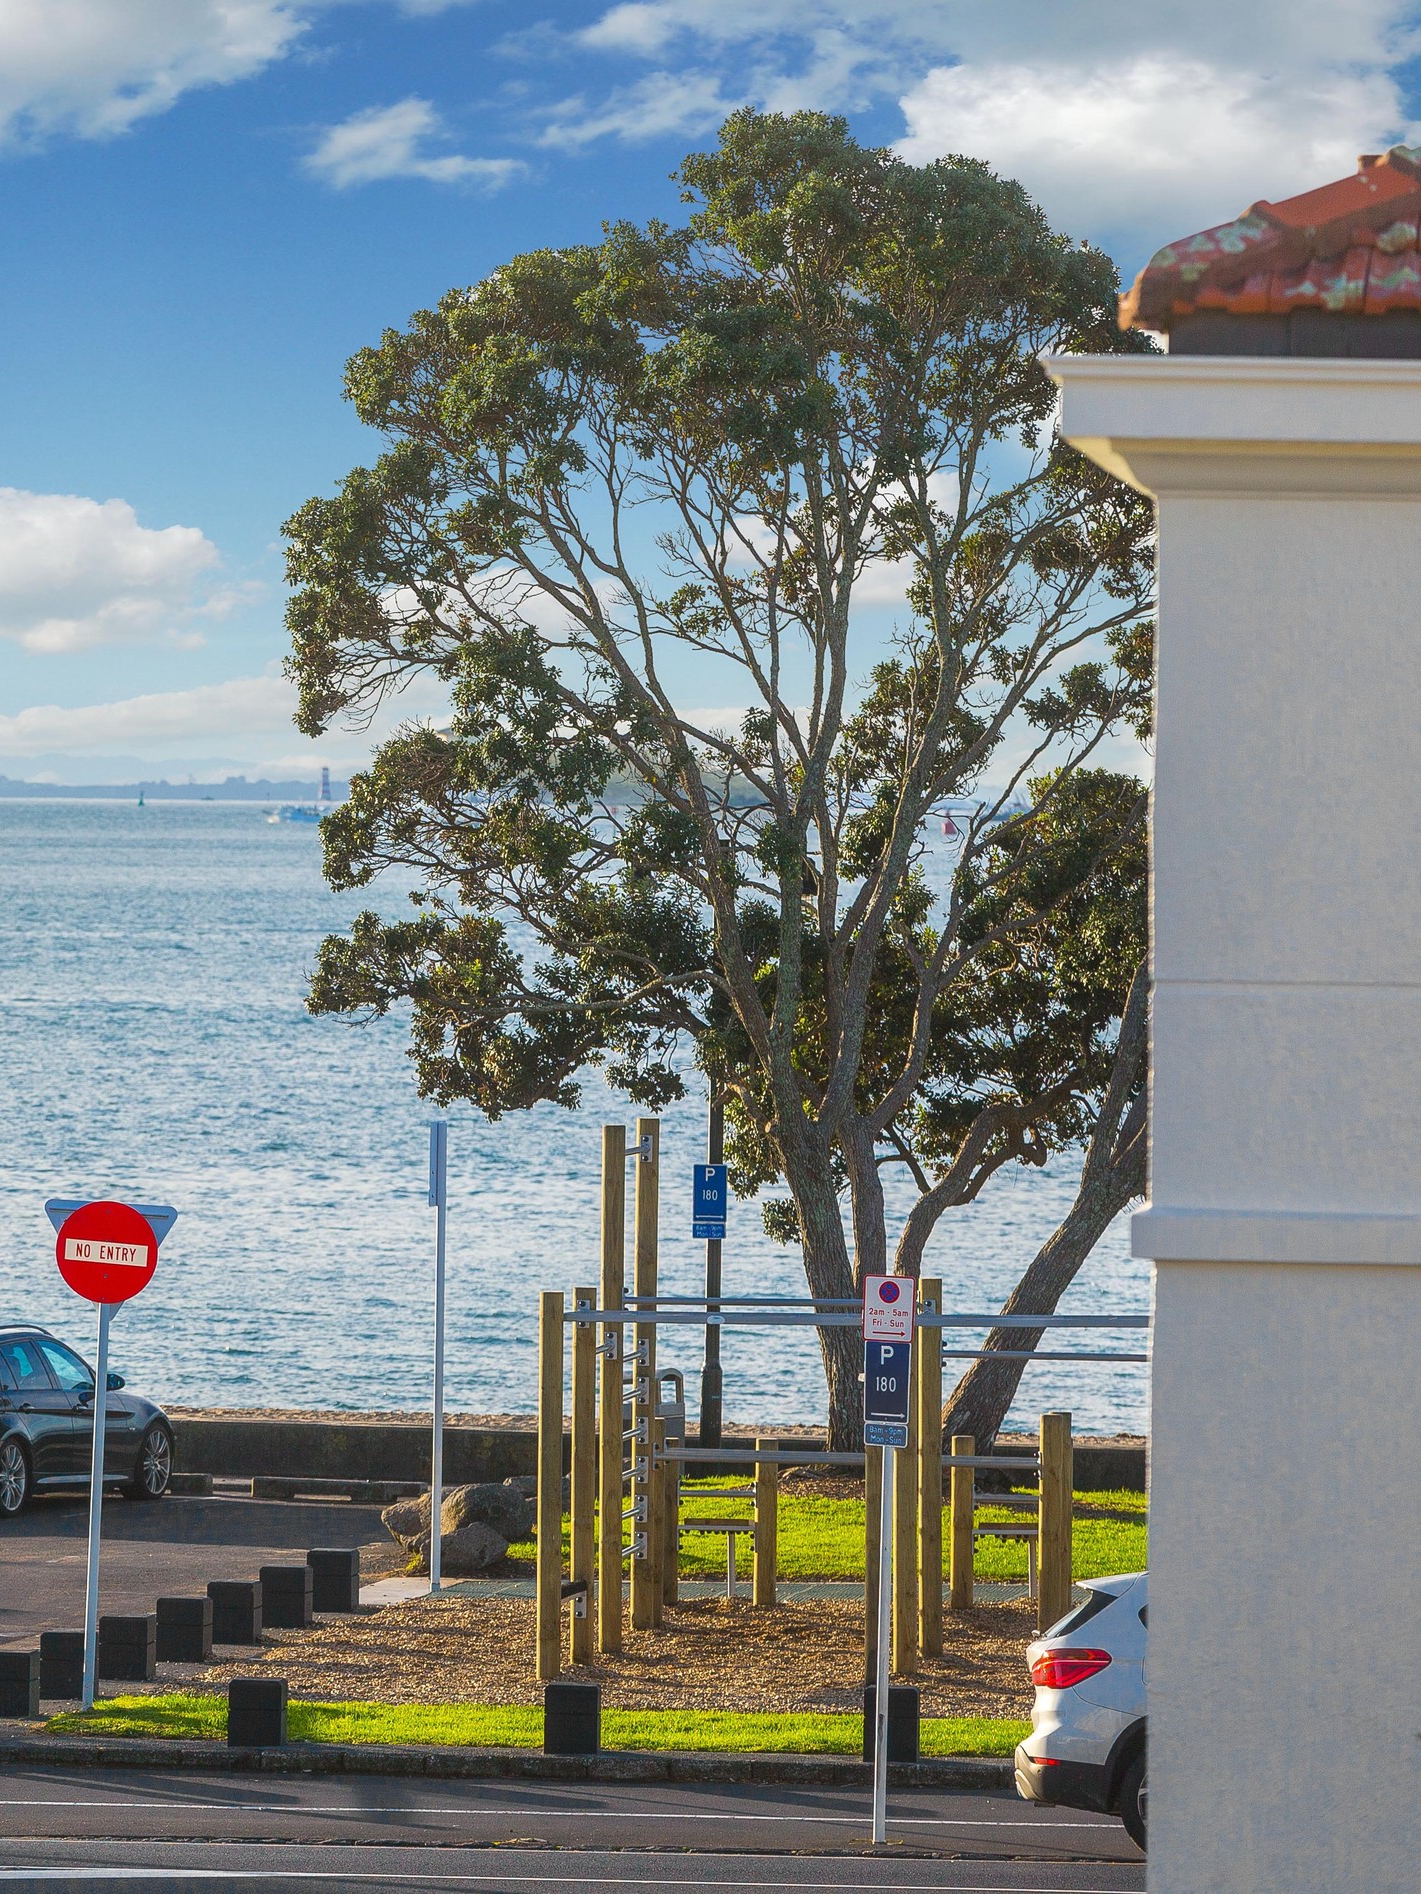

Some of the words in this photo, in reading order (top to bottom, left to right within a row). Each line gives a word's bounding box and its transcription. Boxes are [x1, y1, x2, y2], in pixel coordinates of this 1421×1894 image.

[705, 1167, 716, 1182] P
[702, 1189, 718, 1201] 180
[75, 1243, 91, 1258] NO
[99, 1245, 137, 1262] ENTRY
[868, 1307, 885, 1316] 2am
[892, 1308, 909, 1317] 5am
[872, 1318, 883, 1326] Fri
[889, 1319, 905, 1328] Sun
[880, 1345, 895, 1365] P
[875, 1376, 897, 1393] 180
[869, 1425, 884, 1434] 8am
[888, 1427, 904, 1436] 9pm
[869, 1434, 885, 1443] Mon
[889, 1435, 902, 1444] Sun
